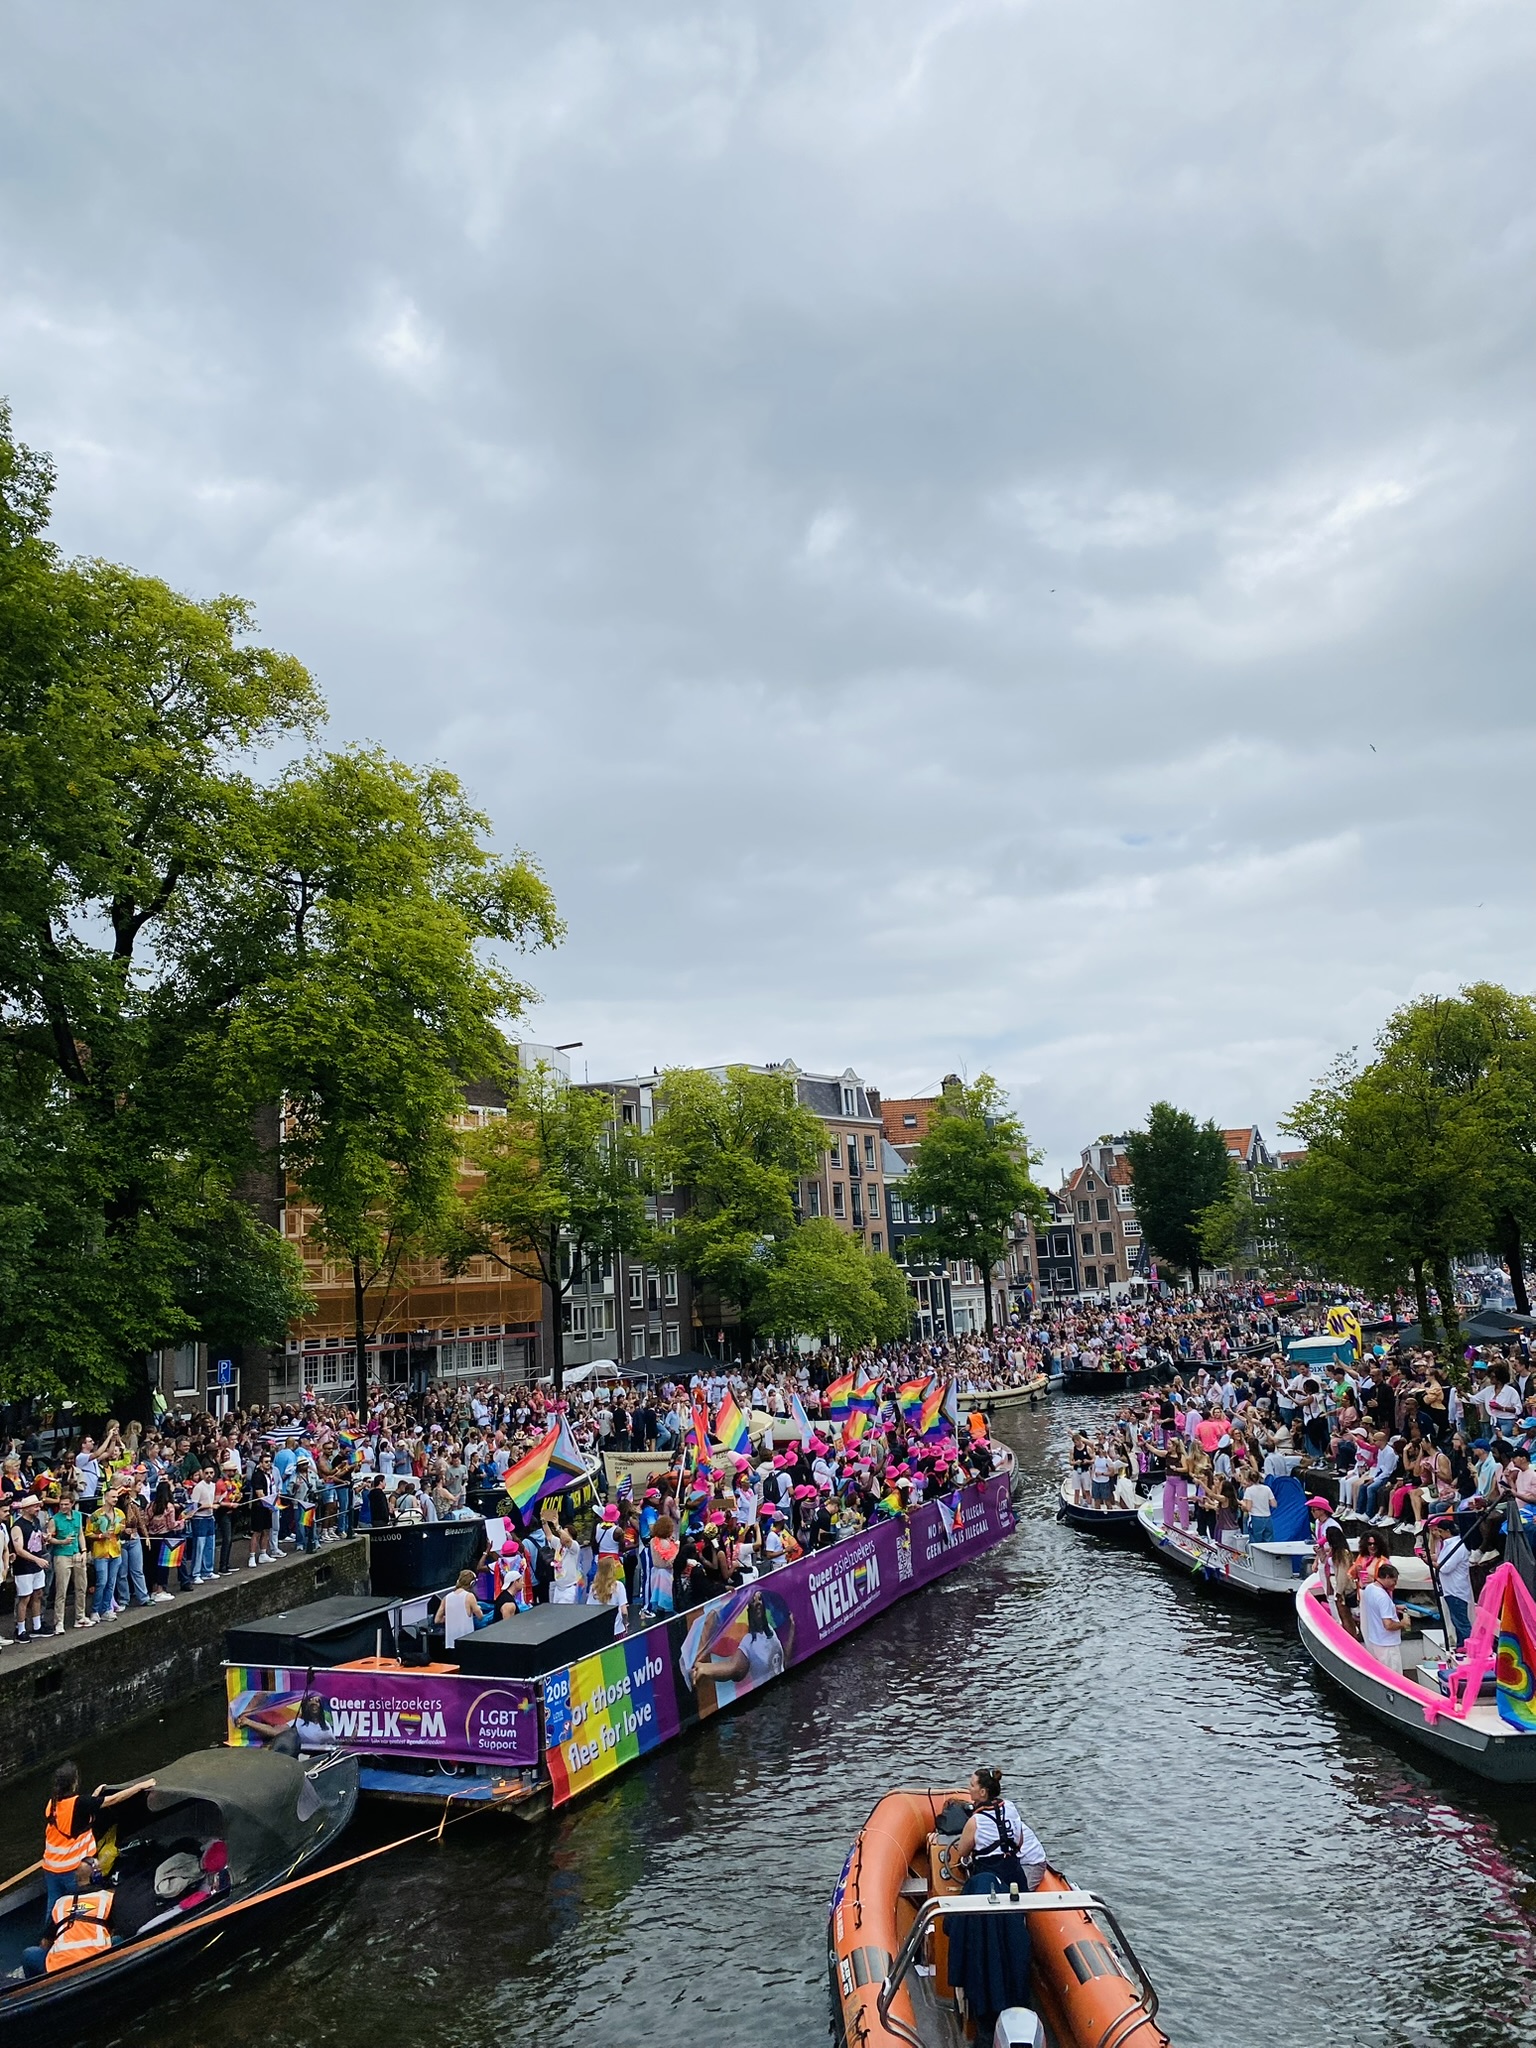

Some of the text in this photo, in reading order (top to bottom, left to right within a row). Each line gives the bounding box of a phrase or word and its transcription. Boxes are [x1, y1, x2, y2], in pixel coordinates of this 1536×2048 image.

[1329, 1313, 1356, 1335] WC
[221, 1362, 228, 1374] P
[965, 1502, 985, 1521] ILLEGAL
[808, 1539, 876, 1592] Queer asielzoekers
[546, 1680, 568, 1703] 20B
[572, 1656, 663, 1727] or those who
[329, 1697, 442, 1711] Queer asielzoekers
[479, 1709, 518, 1726] LGBT
[479, 1727, 517, 1739] Asylum
[569, 1703, 652, 1774] flee for love
[478, 1738, 518, 1751] Support
